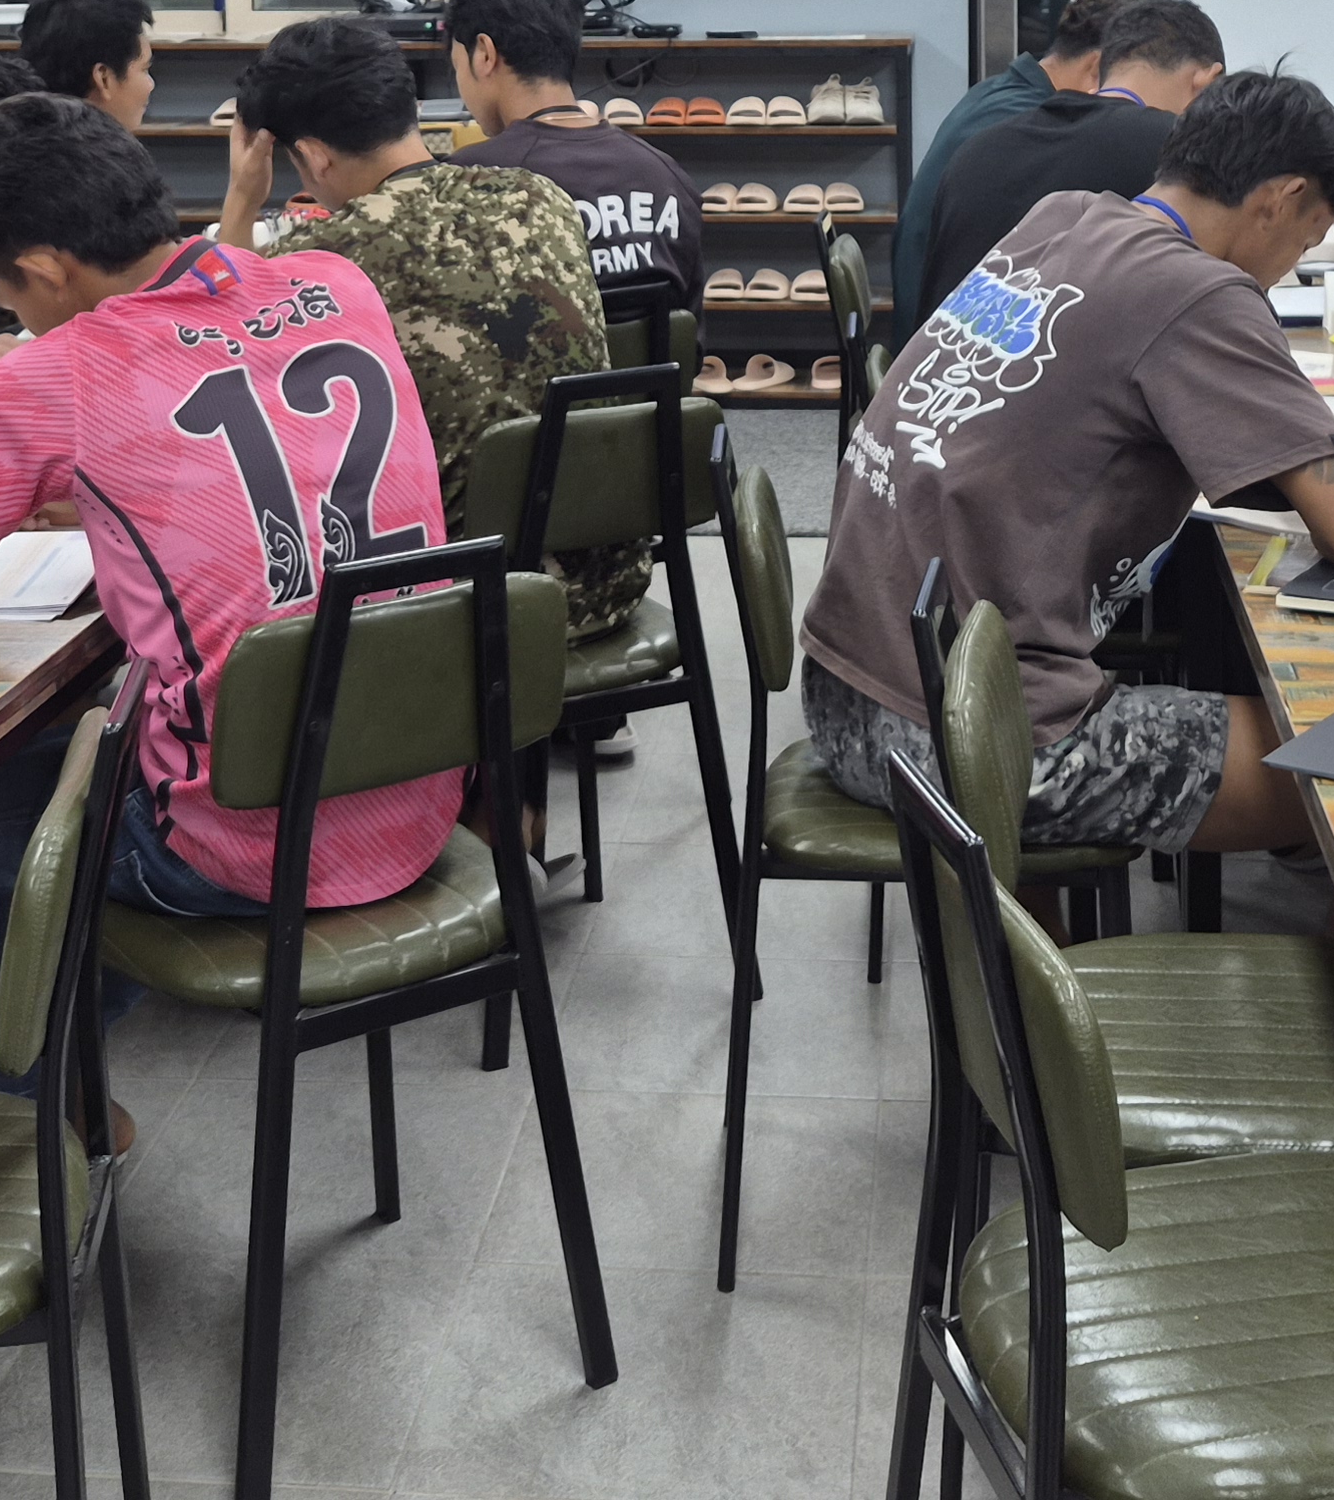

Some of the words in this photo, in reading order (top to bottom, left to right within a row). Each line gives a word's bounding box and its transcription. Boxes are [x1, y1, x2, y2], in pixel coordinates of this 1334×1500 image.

[583, 191, 680, 241] OREA
[591, 240, 655, 276] RMY
[170, 339, 429, 611] 12
